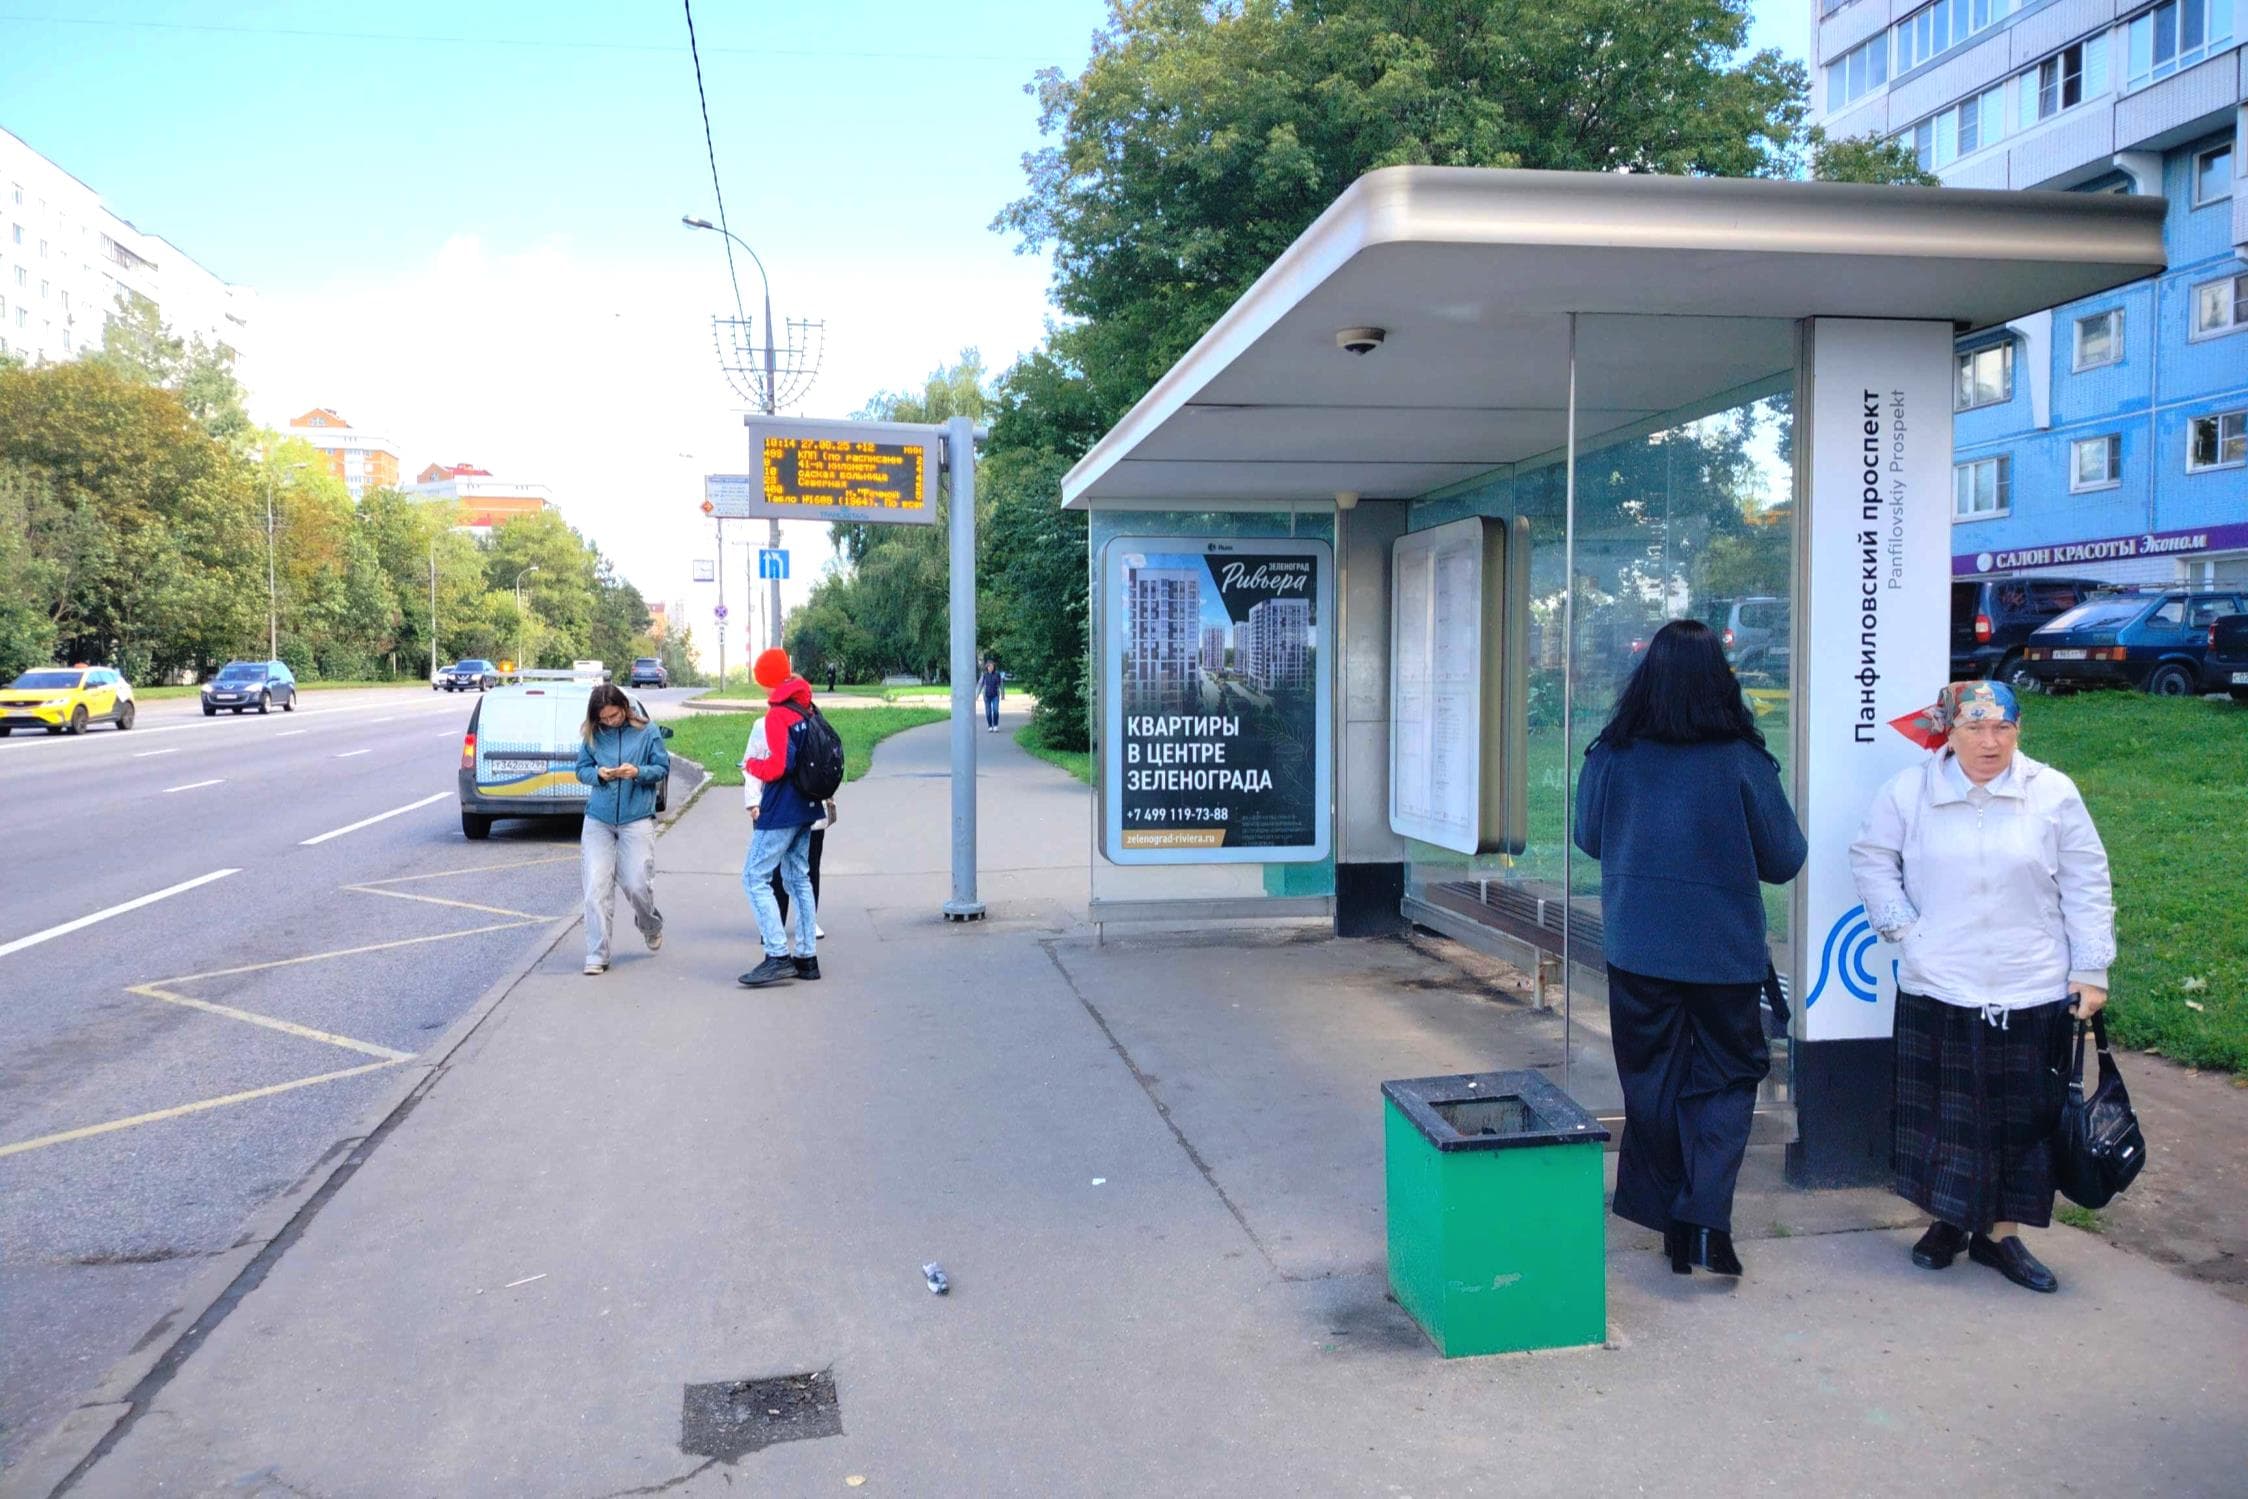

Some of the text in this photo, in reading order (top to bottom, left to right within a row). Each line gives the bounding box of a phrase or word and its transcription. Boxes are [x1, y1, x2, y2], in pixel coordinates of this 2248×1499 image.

[765, 438, 796, 448] 10:14
[1888, 389, 1908, 590] Panfilovskiy Prospekt
[1996, 533, 2208, 569] САЛОН КРАСОТЫ Эконом
[1268, 562, 1310, 573] ЗЕЛЕНОГРАД
[1854, 388, 1883, 744] Панфиловский проспект
[1221, 561, 1307, 596] Ривьера
[1127, 716, 1240, 737] КВАРТИРЫ
[1127, 743, 1226, 767] В ЦЕНТРЕ
[1127, 769, 1273, 793] ЗЕЛЕНОГРАДА
[1127, 807, 1229, 821] +7 499 119-73-88
[1126, 833, 1215, 847] zelenograd-riviera.ru
